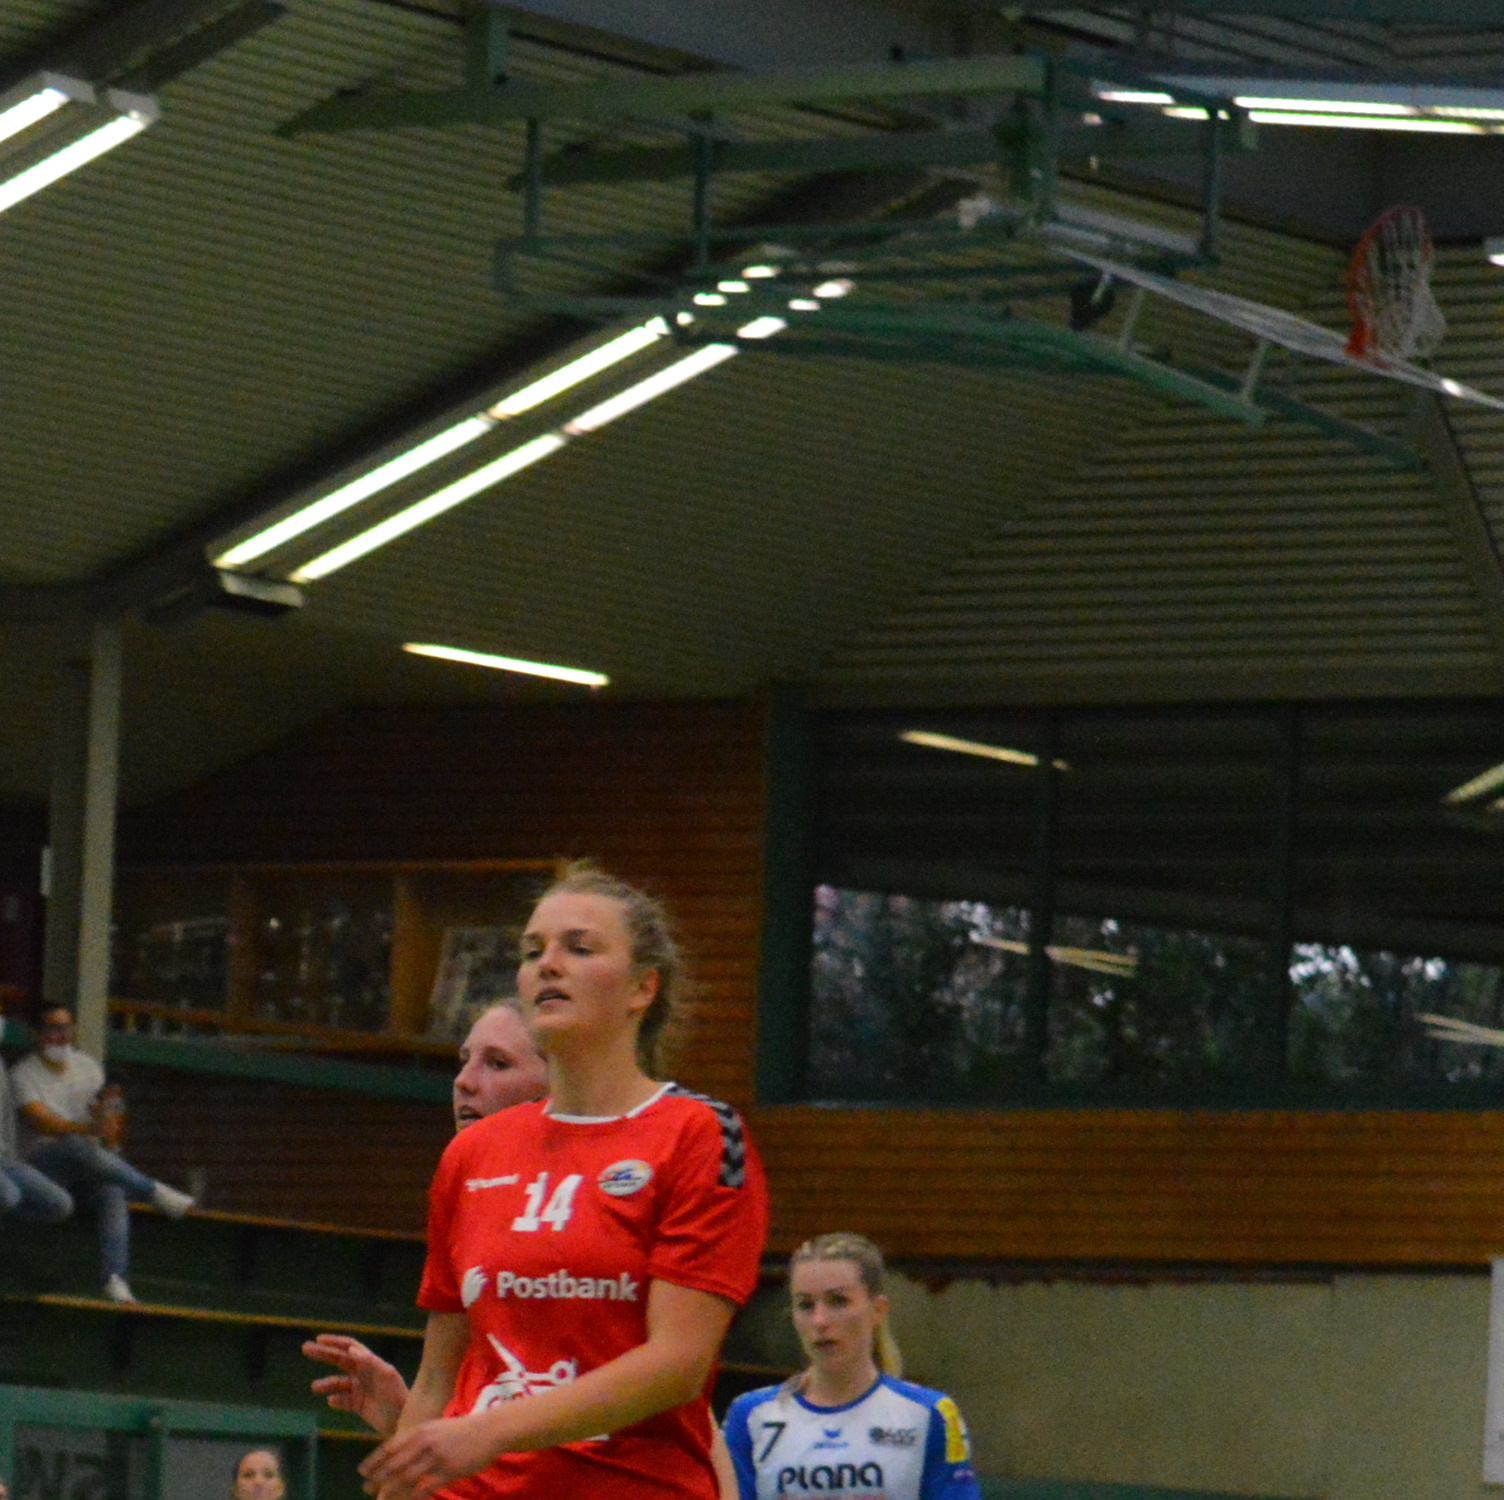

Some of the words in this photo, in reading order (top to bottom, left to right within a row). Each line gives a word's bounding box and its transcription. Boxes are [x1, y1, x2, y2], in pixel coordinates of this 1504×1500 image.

[511, 1172, 583, 1232] 14
[496, 1268, 639, 1302] Postbank
[760, 1422, 786, 1463] 7
